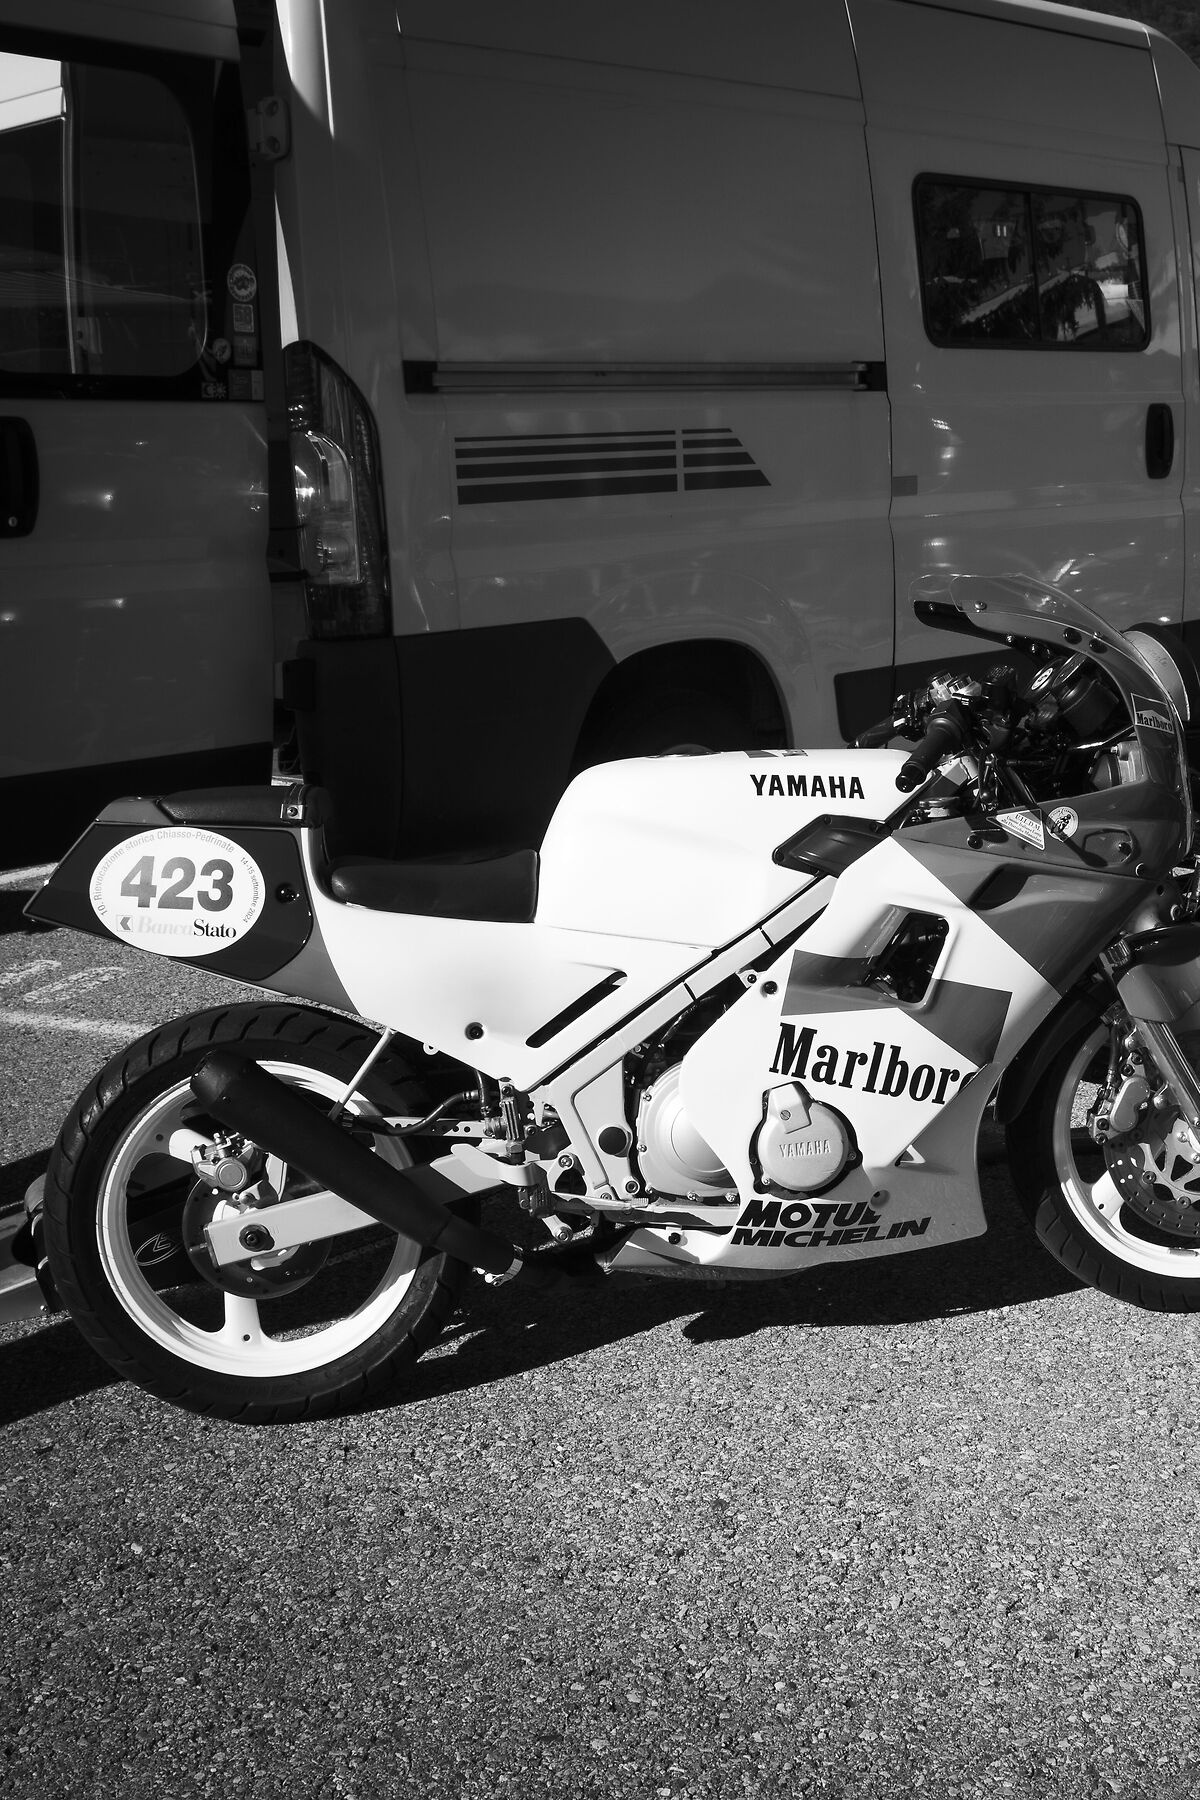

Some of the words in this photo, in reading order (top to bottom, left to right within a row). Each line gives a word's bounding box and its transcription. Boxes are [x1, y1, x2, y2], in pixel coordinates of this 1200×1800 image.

[1136, 712, 1172, 732] Marlboro
[749, 774, 865, 799] YAMAHA
[94, 848, 125, 901] Rievocazione
[126, 834, 155, 850] storica
[157, 830, 235, 853] Chiasso-Pedrinate
[120, 855, 234, 912] 423
[779, 1139, 831, 1158] YAMAHA
[736, 1199, 882, 1229] MOTUL
[730, 1216, 931, 1248] MICHELIN
